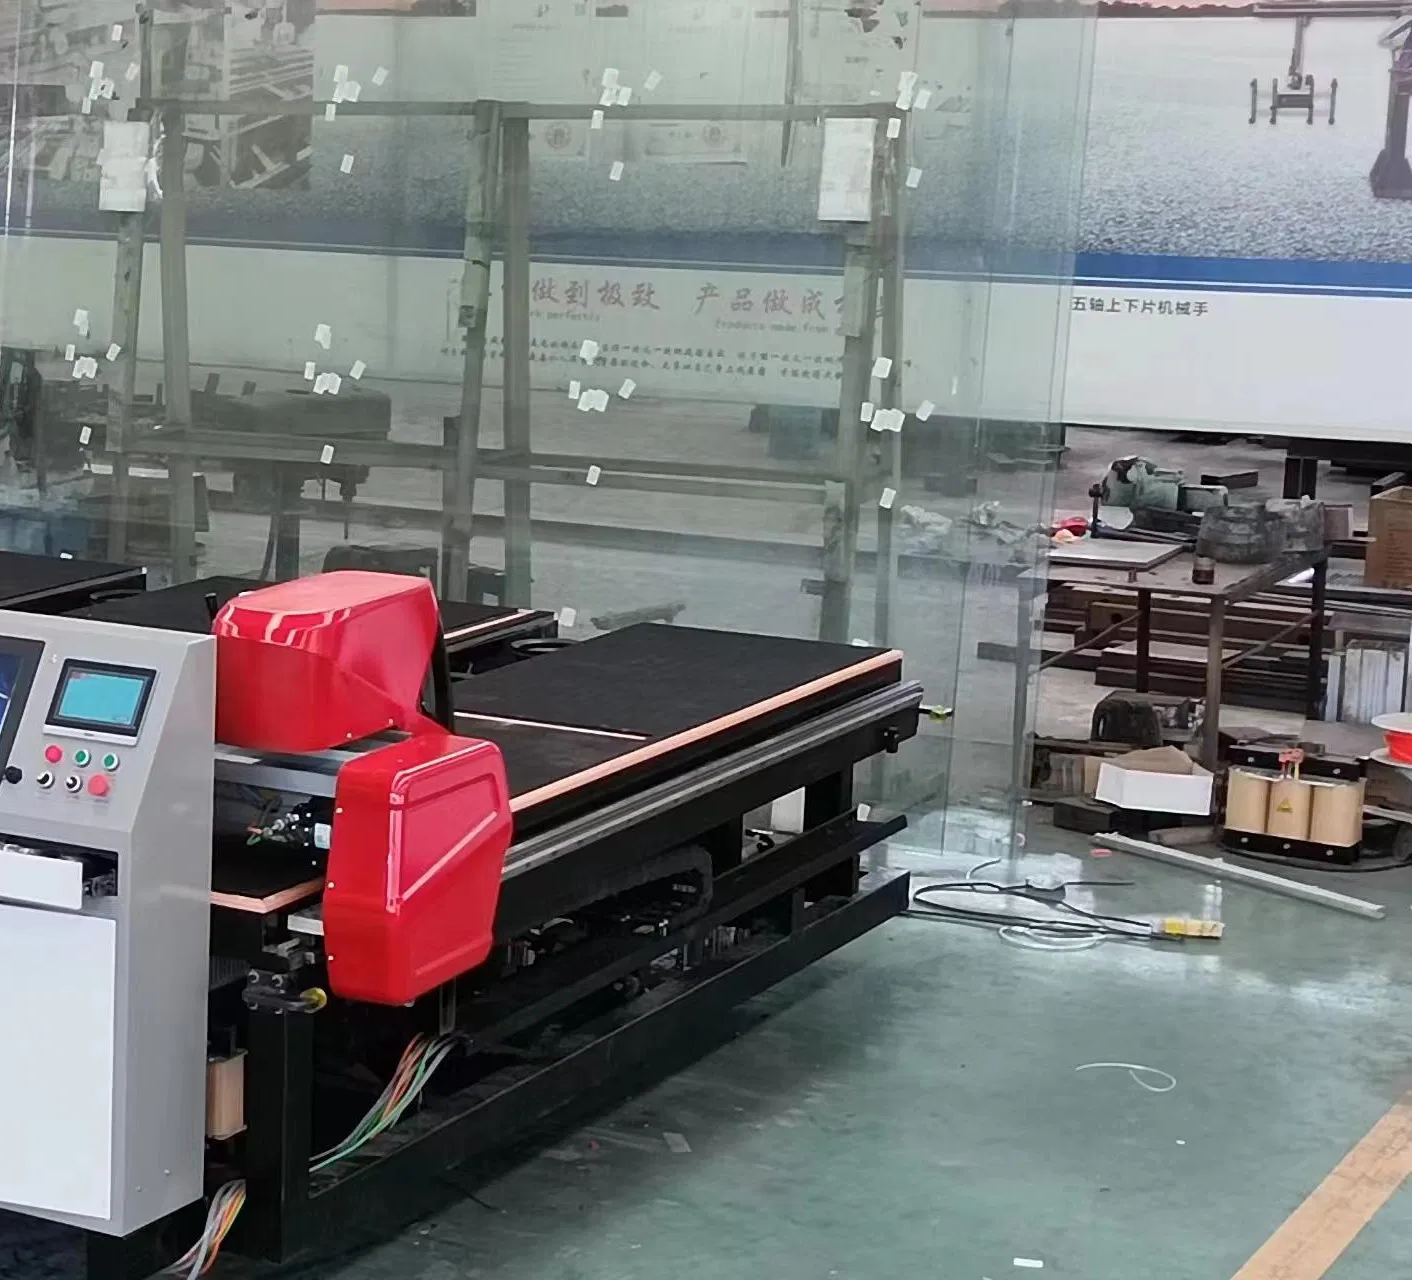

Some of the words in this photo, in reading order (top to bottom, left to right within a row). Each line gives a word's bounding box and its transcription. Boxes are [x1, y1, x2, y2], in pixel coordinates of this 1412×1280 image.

[1071, 296, 1208, 316] 五轴上下片机械手
